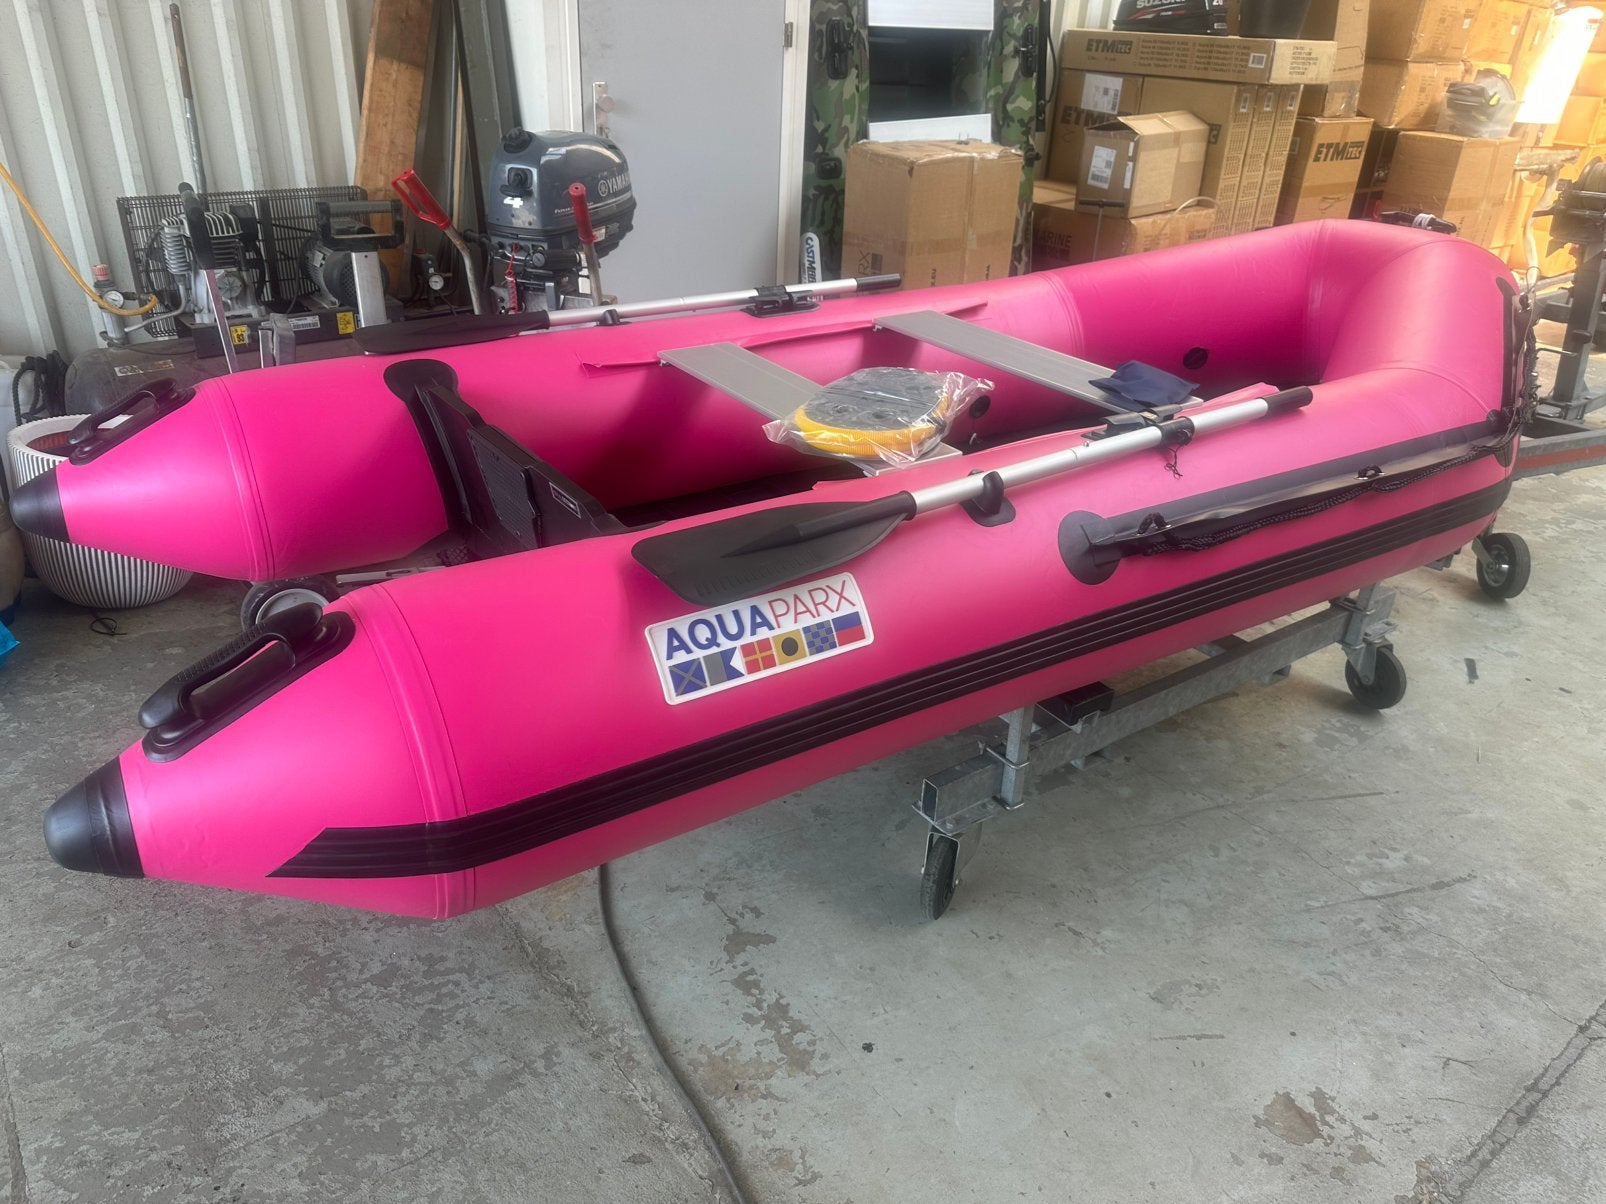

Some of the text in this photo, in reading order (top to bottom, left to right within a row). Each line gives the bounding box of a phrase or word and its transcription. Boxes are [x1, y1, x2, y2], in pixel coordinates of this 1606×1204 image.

[607, 171, 633, 194] YAMAH
[503, 196, 524, 209] 4
[665, 579, 857, 662] AQUAPARX
